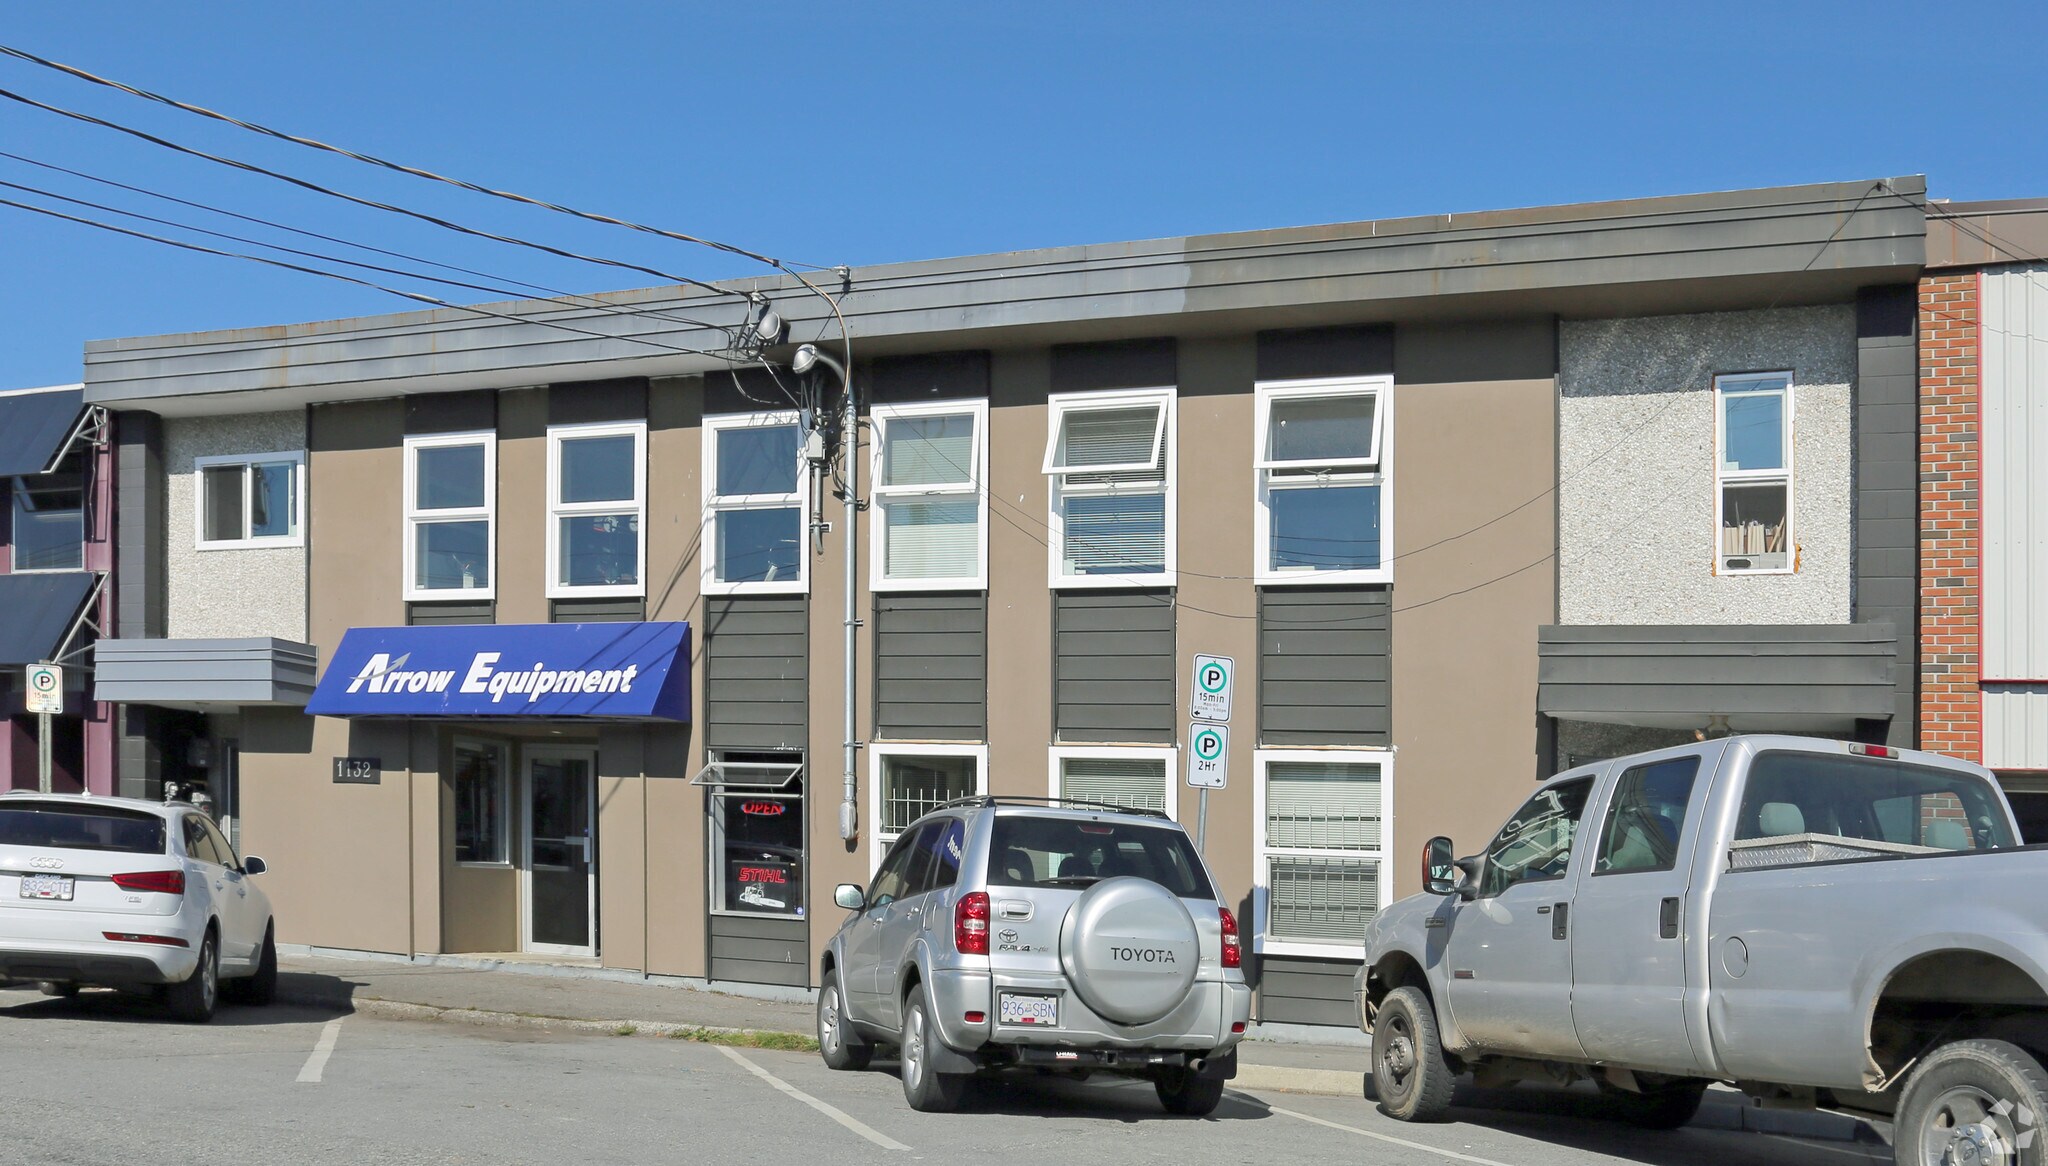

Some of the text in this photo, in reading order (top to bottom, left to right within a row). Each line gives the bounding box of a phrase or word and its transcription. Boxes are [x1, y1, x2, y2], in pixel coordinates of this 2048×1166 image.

[40, 675, 51, 687] P
[346, 652, 638, 703] Arrow Equipment
[1207, 670, 1220, 686] P
[1203, 737, 1216, 753] P
[337, 760, 371, 778] 1132
[1198, 760, 1217, 772] 2Hr
[743, 801, 783, 815] OPEN
[739, 867, 786, 884] STIHL
[1110, 947, 1175, 963] TOYOTA
[1001, 1000, 1025, 1016] 936
[1032, 1002, 1056, 1018] SBN
